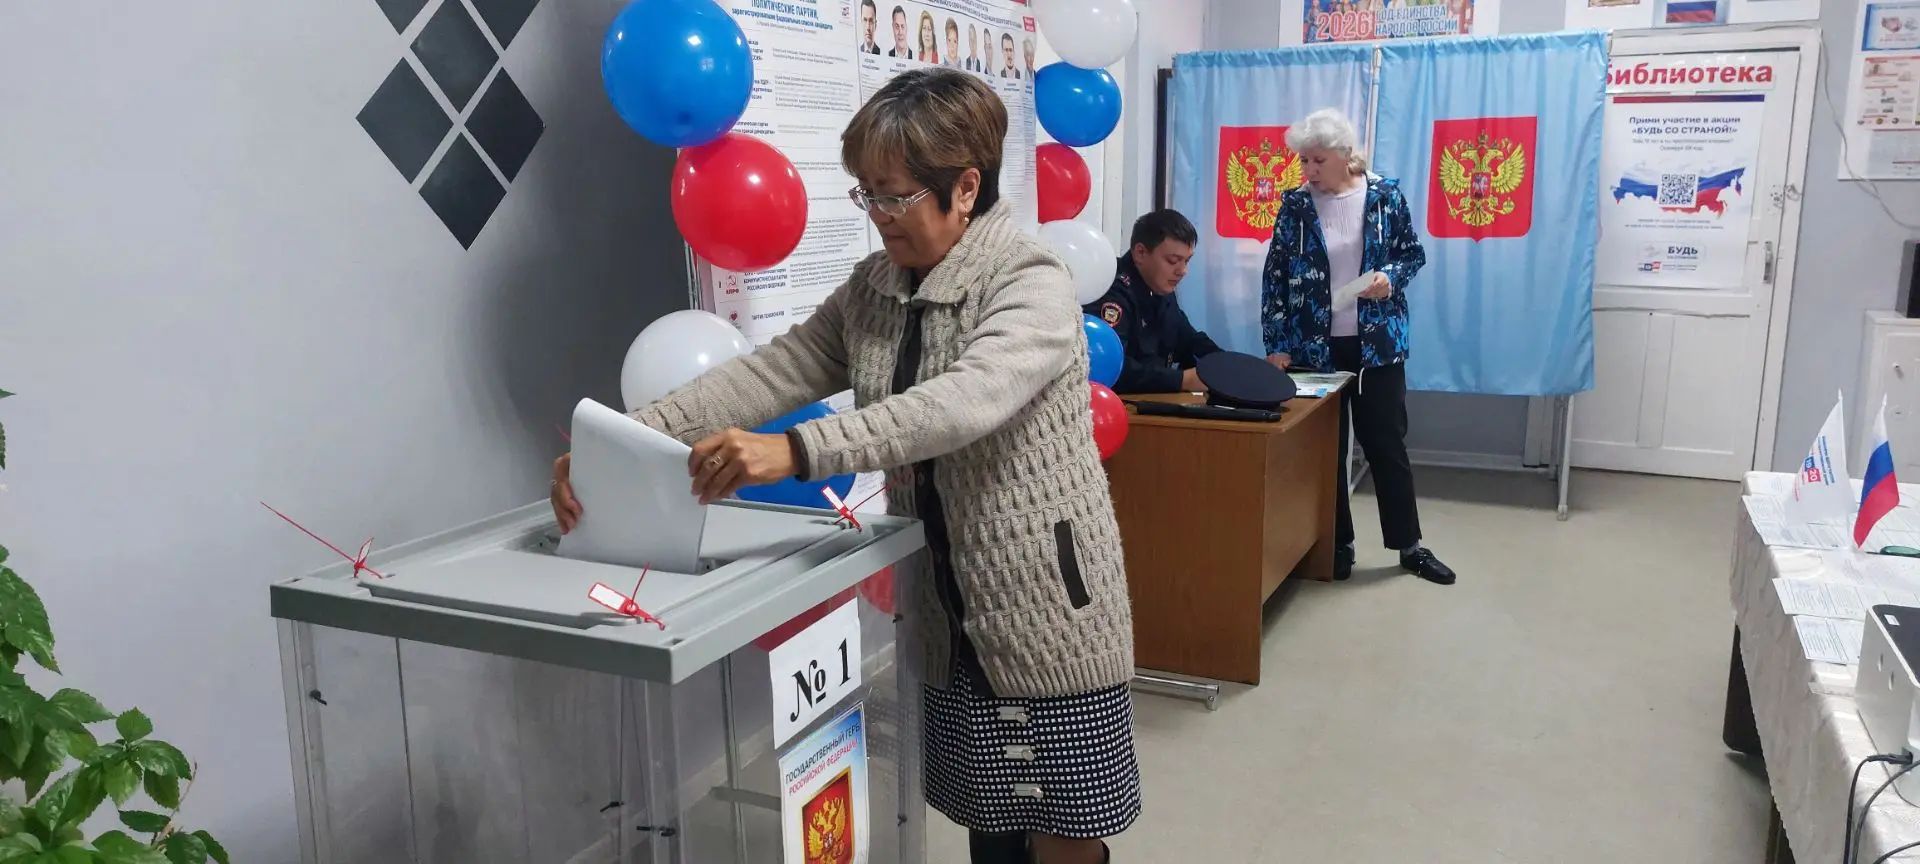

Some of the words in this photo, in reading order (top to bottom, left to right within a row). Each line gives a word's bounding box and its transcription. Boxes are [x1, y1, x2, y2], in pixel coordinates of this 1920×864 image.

[1396, 5, 1446, 20] ЕДИНСТВА
[1317, 11, 1371, 39] 2026
[1375, 20, 1418, 35] НАРОДОВ
[1420, 19, 1457, 33] РОССИИ
[1629, 117, 1660, 125] Прими
[1662, 117, 1701, 125] участие
[1632, 126, 1663, 134] «БУДЬ
[1665, 126, 1679, 134] СО
[1681, 125, 1738, 134] СТРАНОЙ!»
[1668, 246, 1698, 255] БУДЬ
[1809, 469, 1818, 481] 20
[790, 659, 827, 722] №
[837, 638, 851, 687] 1
[785, 731, 845, 784] ГОСУДАРСТВЕННЫЙ
[845, 722, 860, 739] ГЕРБ
[789, 760, 826, 796] РОССИЙСКОЙ
[826, 738, 858, 767] ФЕДЕРАЦИИ
